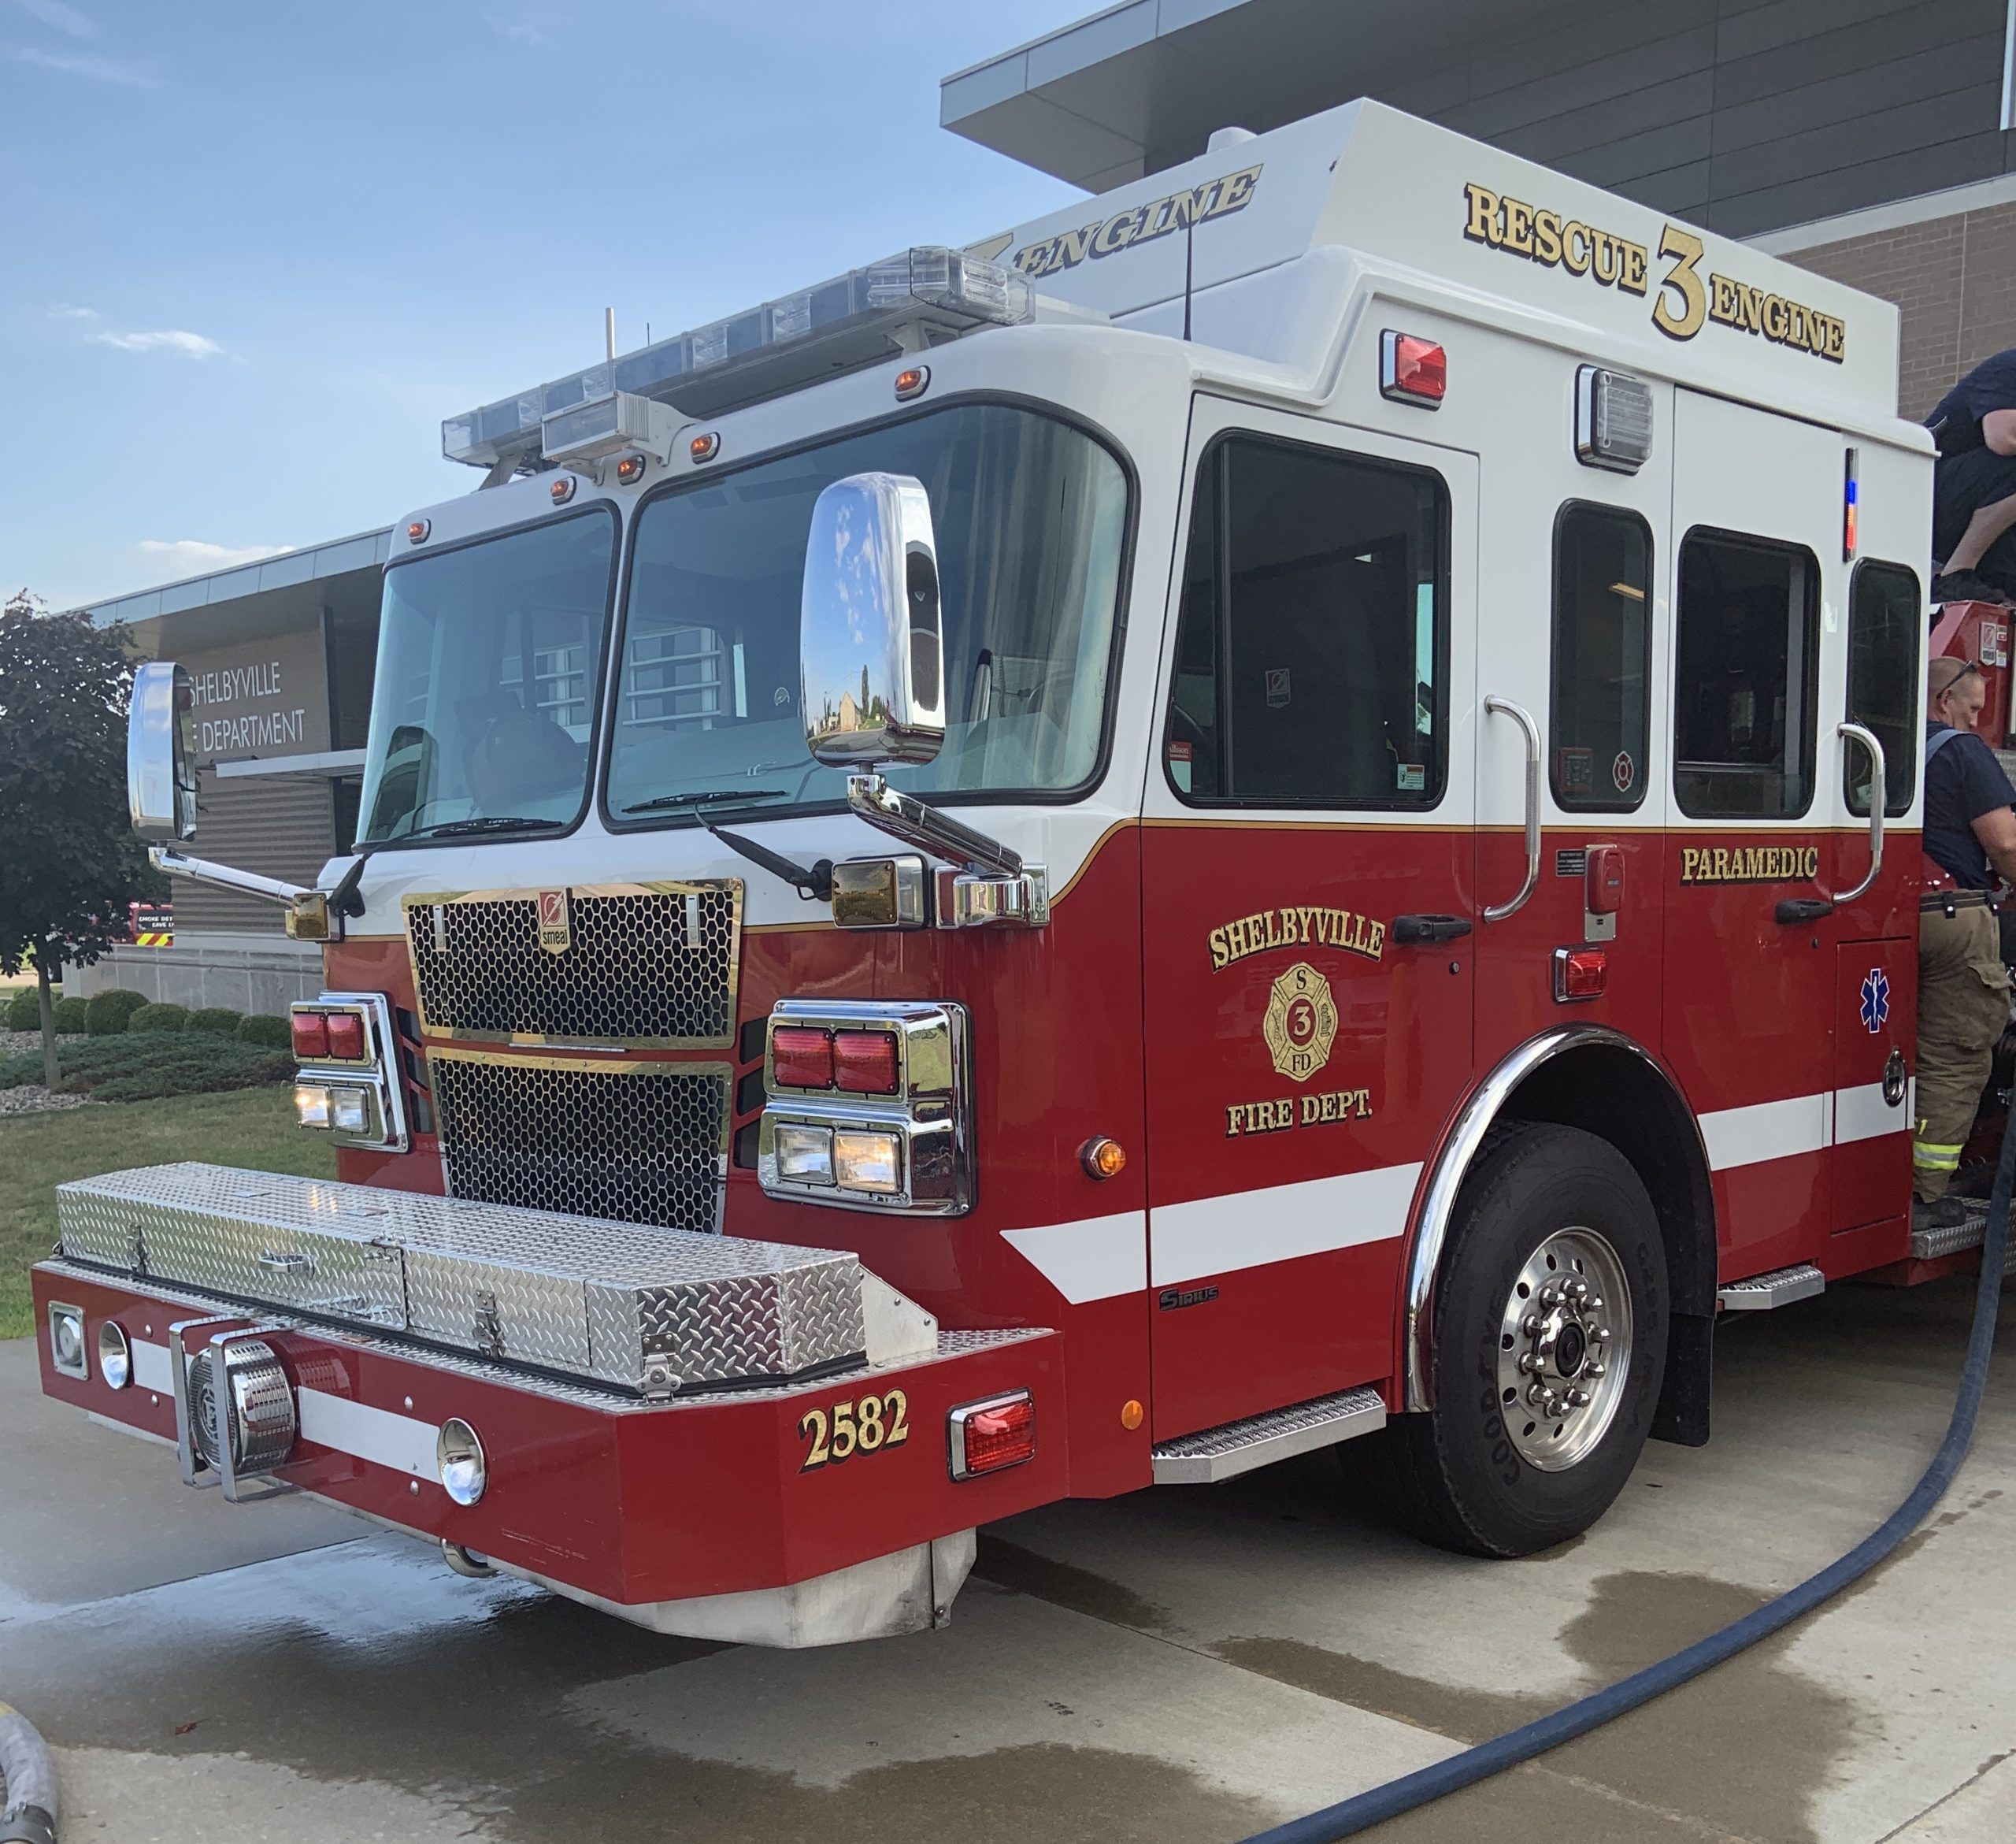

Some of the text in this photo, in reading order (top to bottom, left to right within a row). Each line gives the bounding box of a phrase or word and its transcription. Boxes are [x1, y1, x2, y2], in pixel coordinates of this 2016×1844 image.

[1012, 163, 1264, 279] ENGINE
[1464, 182, 1845, 364] RESCUE 3 ENGINE
[202, 709, 305, 752] DEPARTMENT
[1680, 847, 1818, 886] PARAMEDIC
[543, 929, 568, 944] smeal
[1208, 907, 1386, 974] SHELBYVILLE
[1296, 970, 1306, 990] S
[1292, 1005, 1311, 1037] 3
[1292, 1054, 1311, 1072] FD
[1225, 1089, 1373, 1138] FIRE DEPT.
[798, 1388, 910, 1474] 2582
